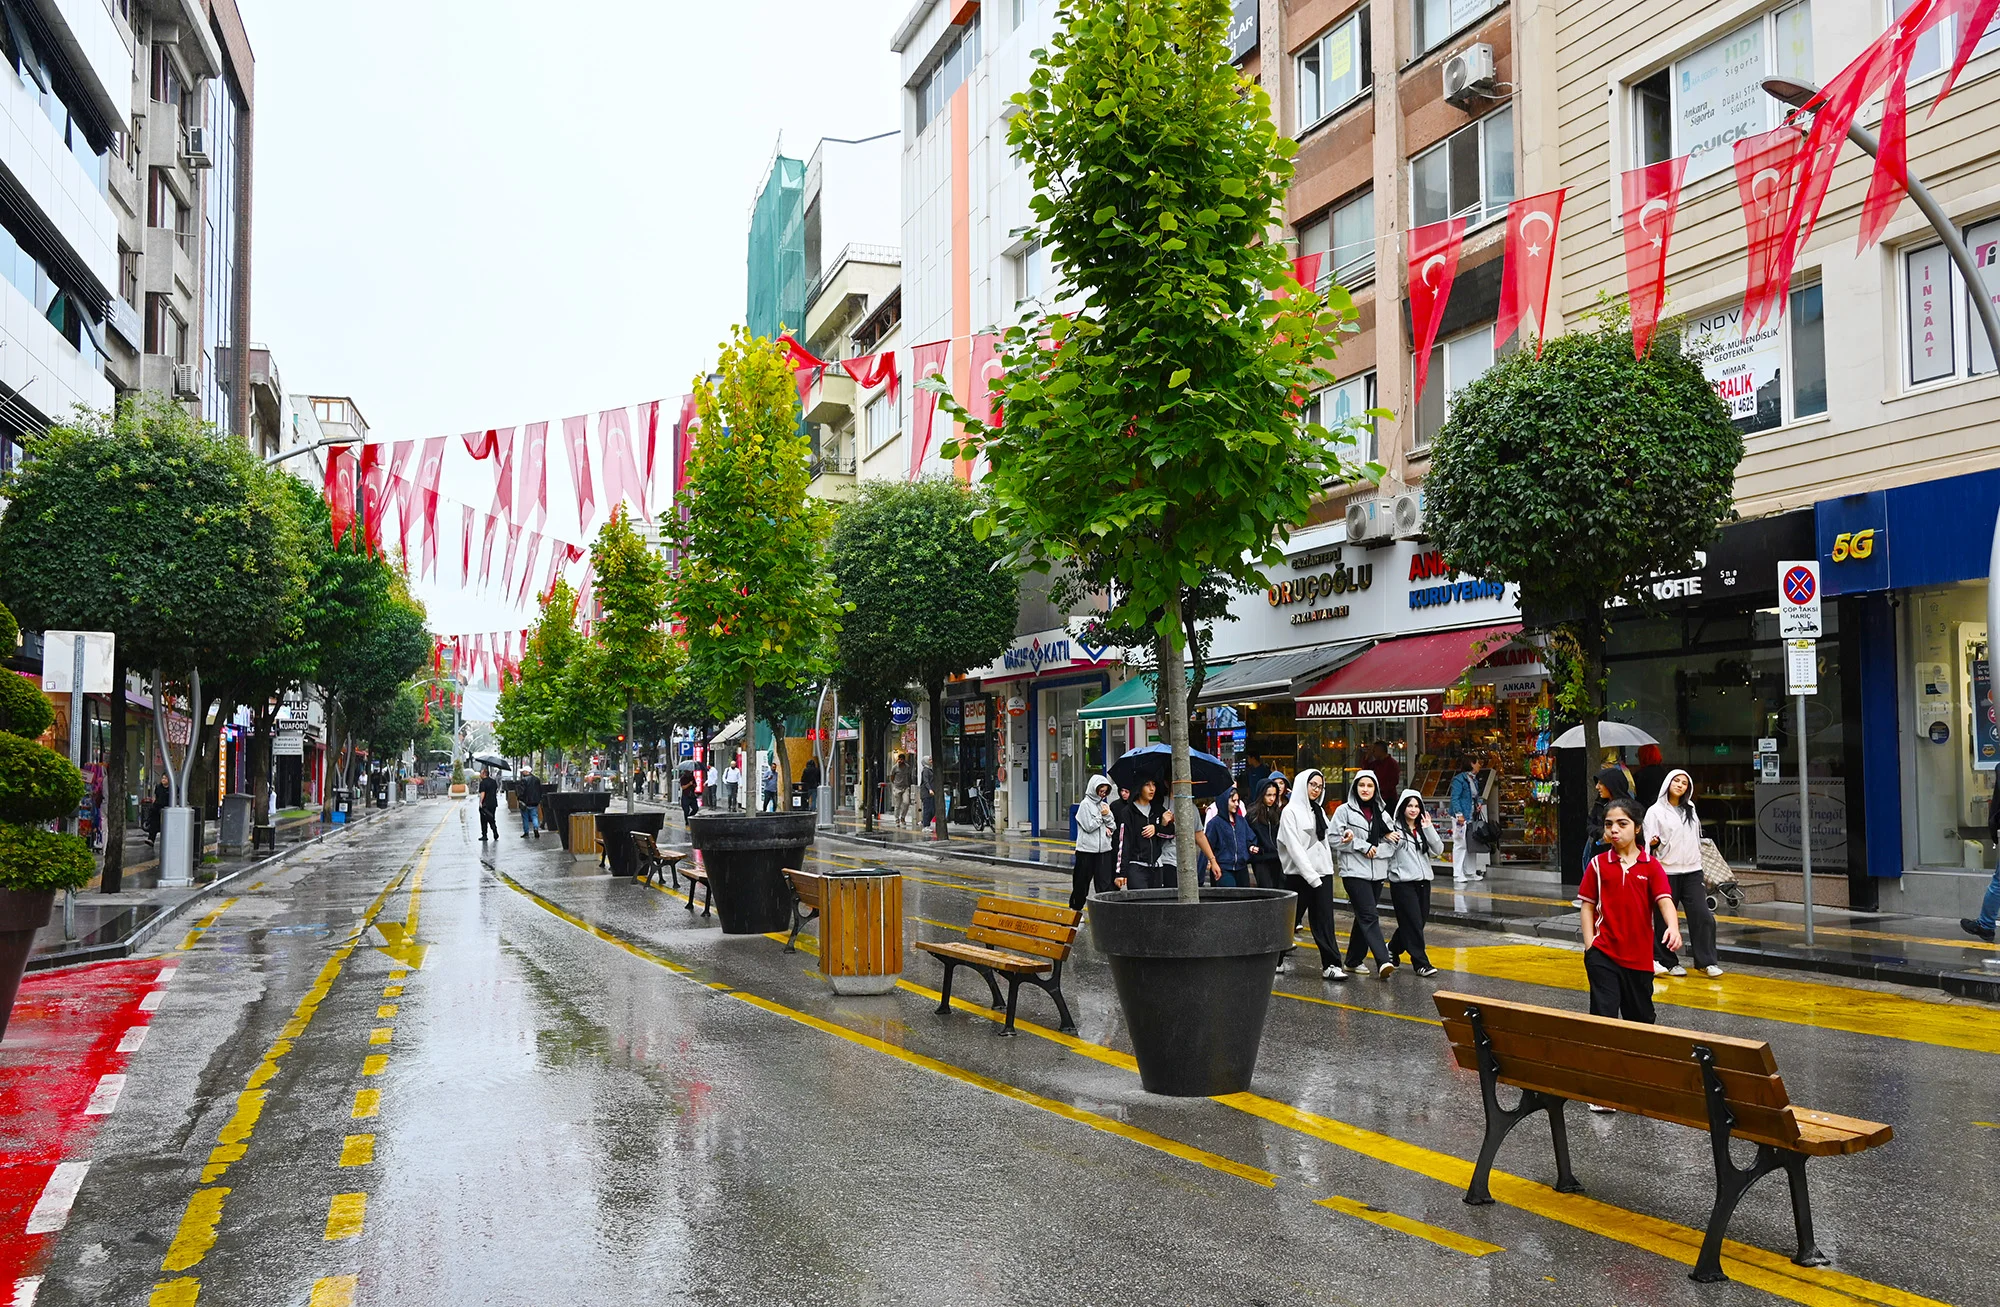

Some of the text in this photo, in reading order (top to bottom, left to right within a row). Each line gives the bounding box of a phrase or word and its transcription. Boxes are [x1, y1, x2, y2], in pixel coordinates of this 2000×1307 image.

[1725, 54, 1759, 77] Sigorta
[1683, 101, 1708, 119] Ankara
[1690, 108, 1715, 127] Sigorta
[1690, 122, 1748, 159] QUICK
[1923, 266, 1934, 357] İNŞAAT
[1714, 345, 1754, 363] GEOTEKNİK
[1722, 363, 1746, 376] MİMAR
[1714, 372, 1753, 399] RALIK
[1832, 528, 1875, 563] 5G
[1291, 547, 1341, 569] GAZİANTEPLİ
[1409, 549, 1451, 581] ANK
[1268, 562, 1373, 607] ORUÇOĞLU
[1290, 605, 1350, 625] BAKLAVALARI
[1783, 605, 1818, 614] ÇÖP TAKSİ
[1790, 612, 1811, 620] HARİÇ
[1003, 647, 1028, 670] VAKIF
[1503, 682, 1536, 692] ANKARA
[1307, 696, 1429, 716] ANKARA KURUYEMİŞ
[681, 742, 690, 755] P
